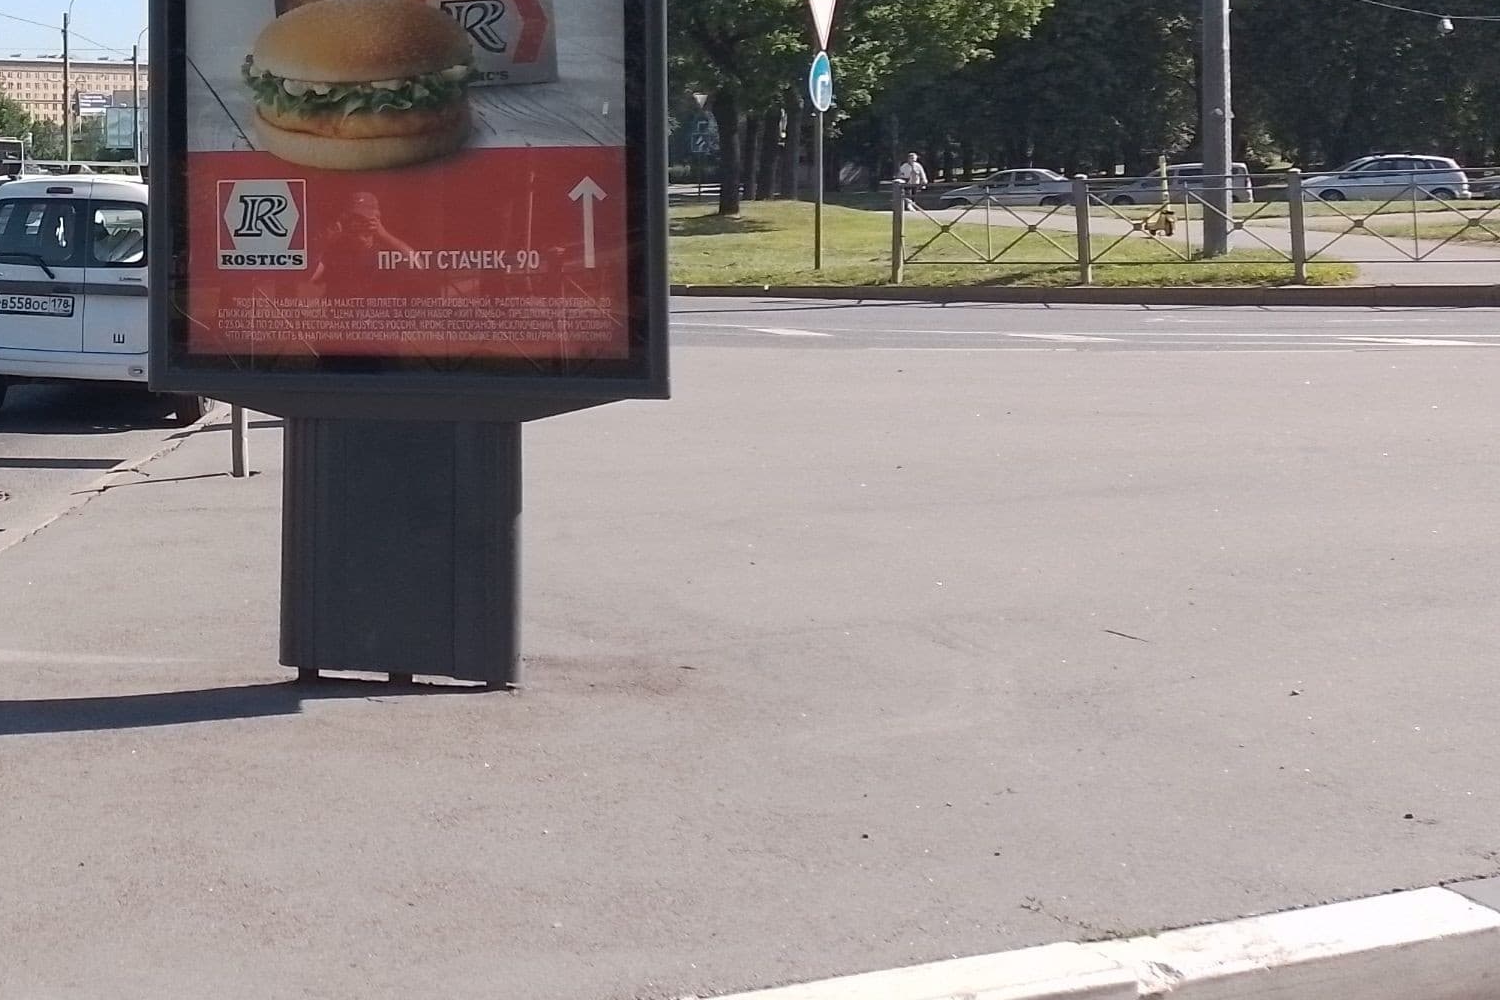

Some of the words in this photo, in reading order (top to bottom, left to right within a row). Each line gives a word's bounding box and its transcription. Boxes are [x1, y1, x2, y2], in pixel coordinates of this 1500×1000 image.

[233, 194, 288, 237] R
[221, 254, 304, 266] ROSTIC'S
[378, 250, 433, 270] ПР-КТ
[436, 250, 512, 273] СТАЧЕК,
[516, 250, 540, 270] 90
